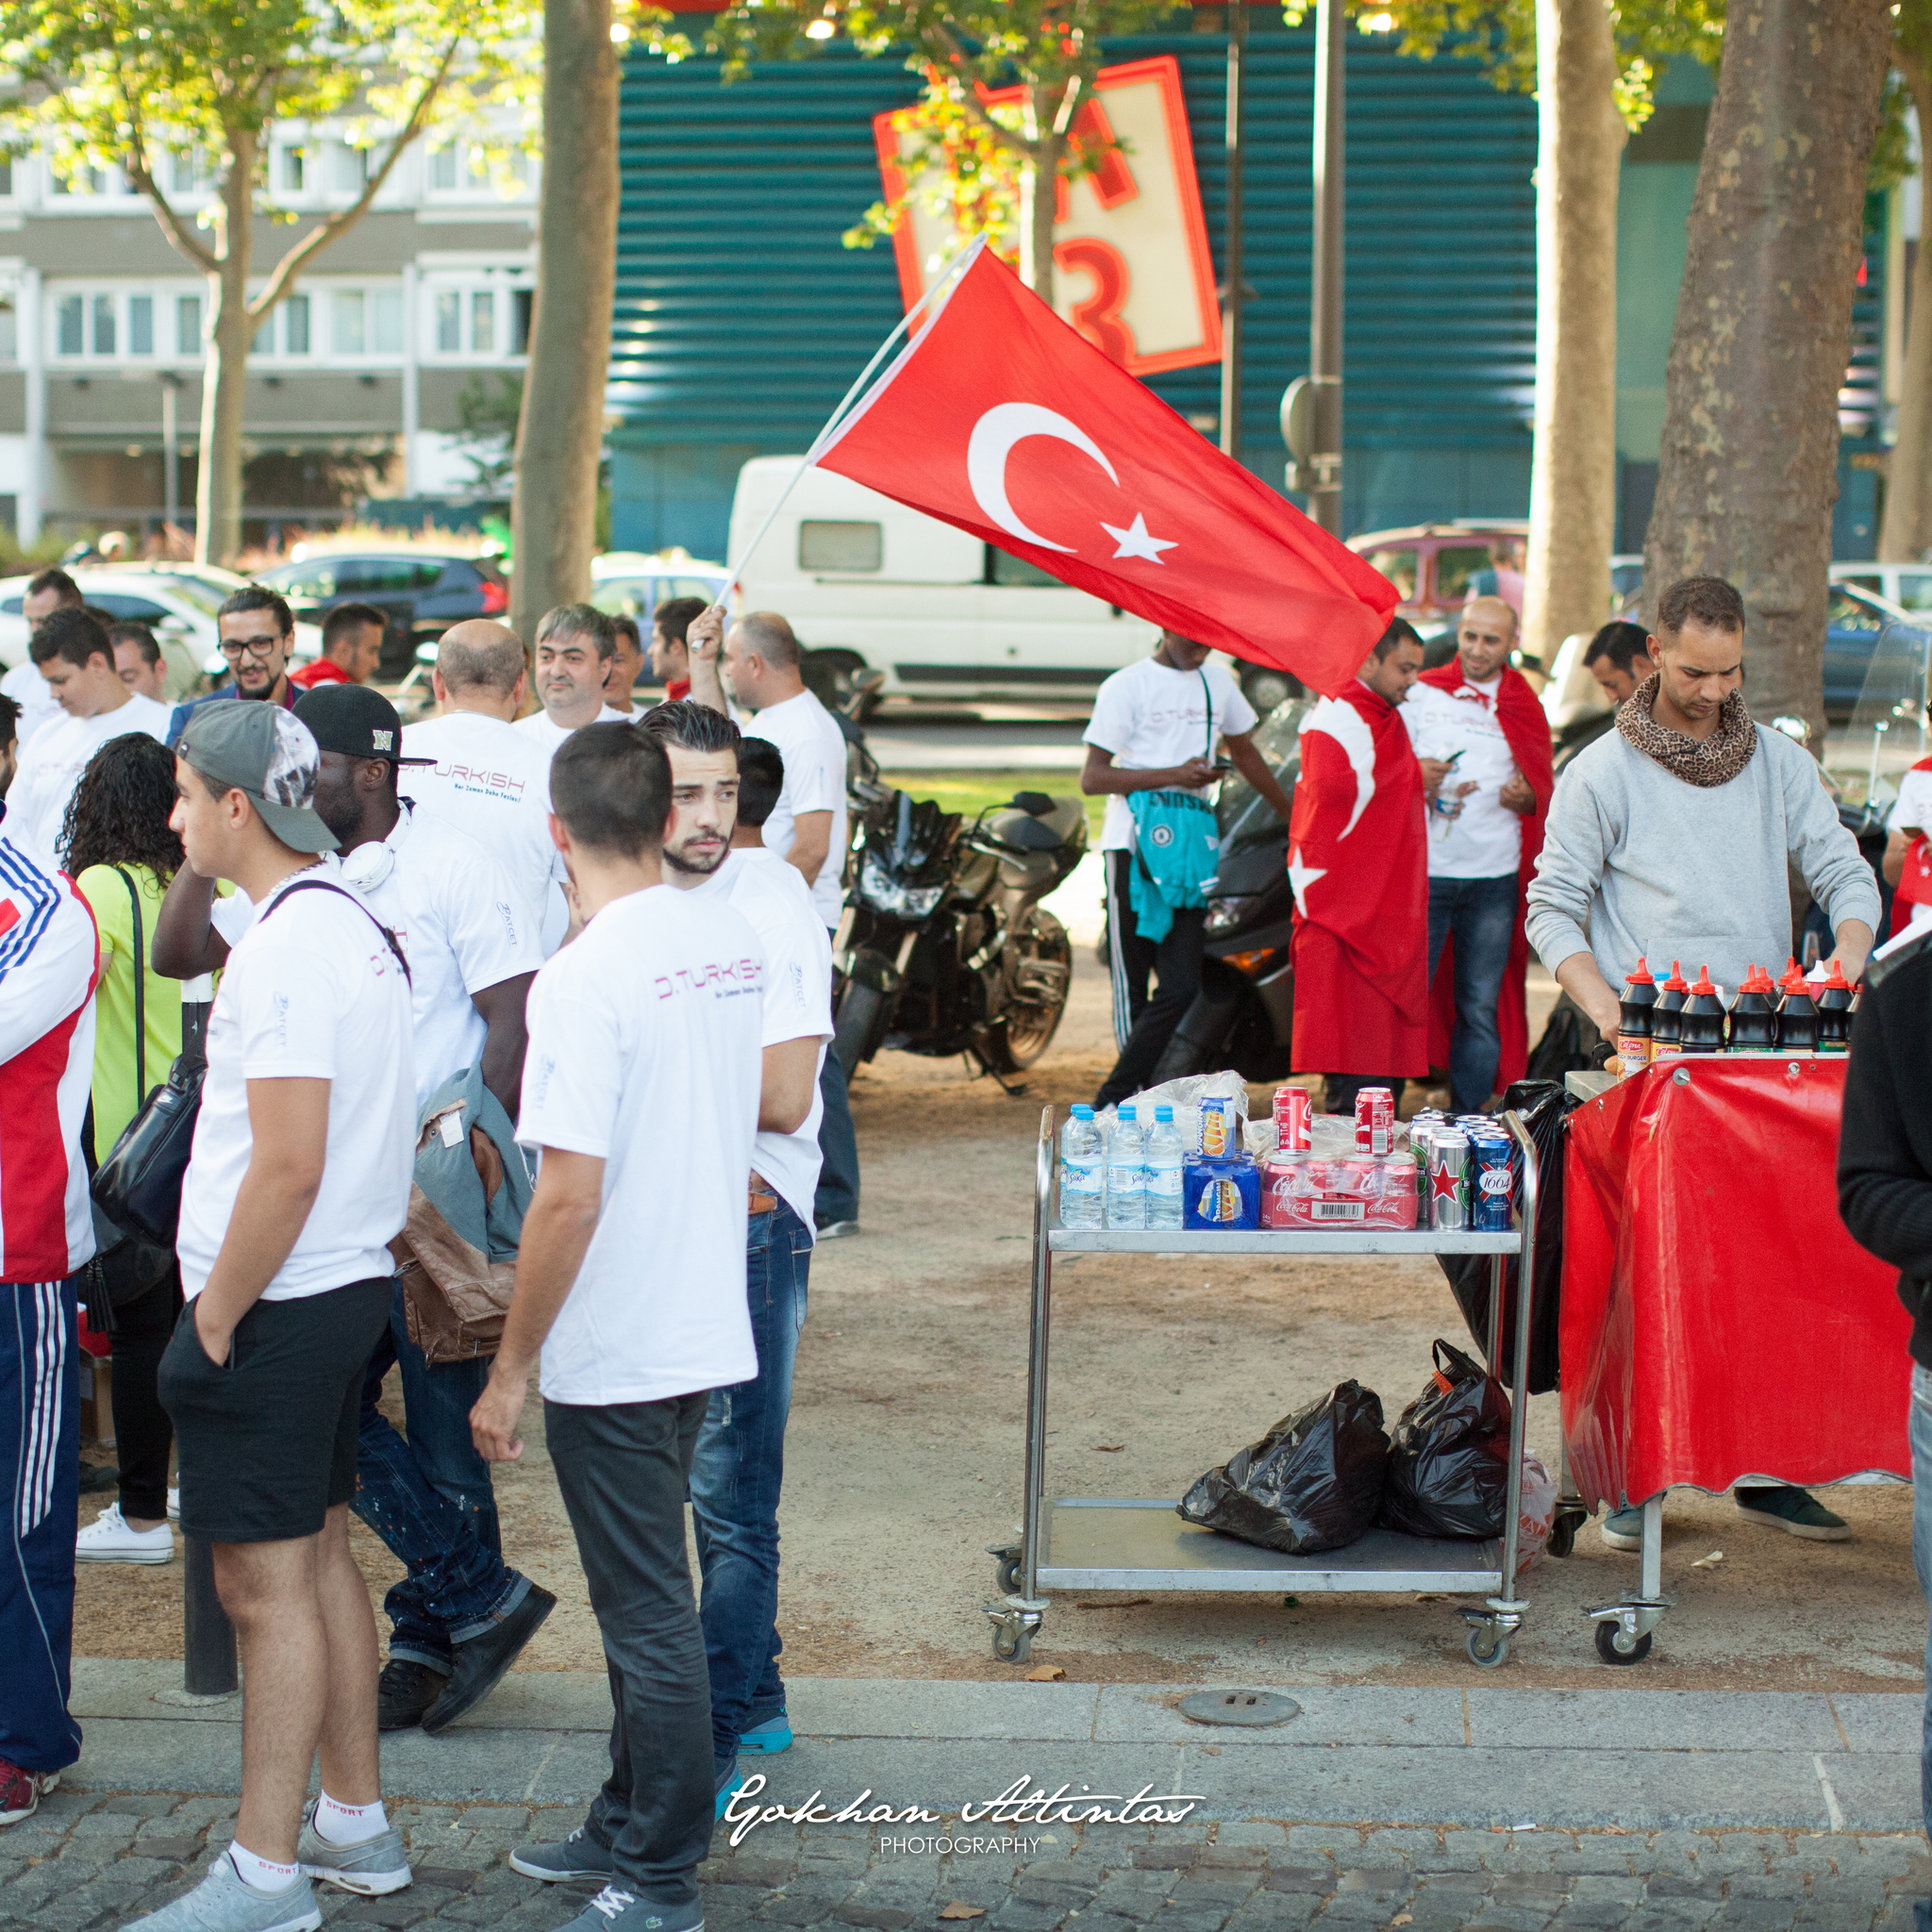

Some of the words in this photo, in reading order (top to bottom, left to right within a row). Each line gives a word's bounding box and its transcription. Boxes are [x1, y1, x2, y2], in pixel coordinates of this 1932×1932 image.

[372, 729, 393, 751] N
[1483, 1175, 1510, 1190] 1664
[326, 1800, 364, 1817] SPORT
[258, 1860, 297, 1875] SPORT
